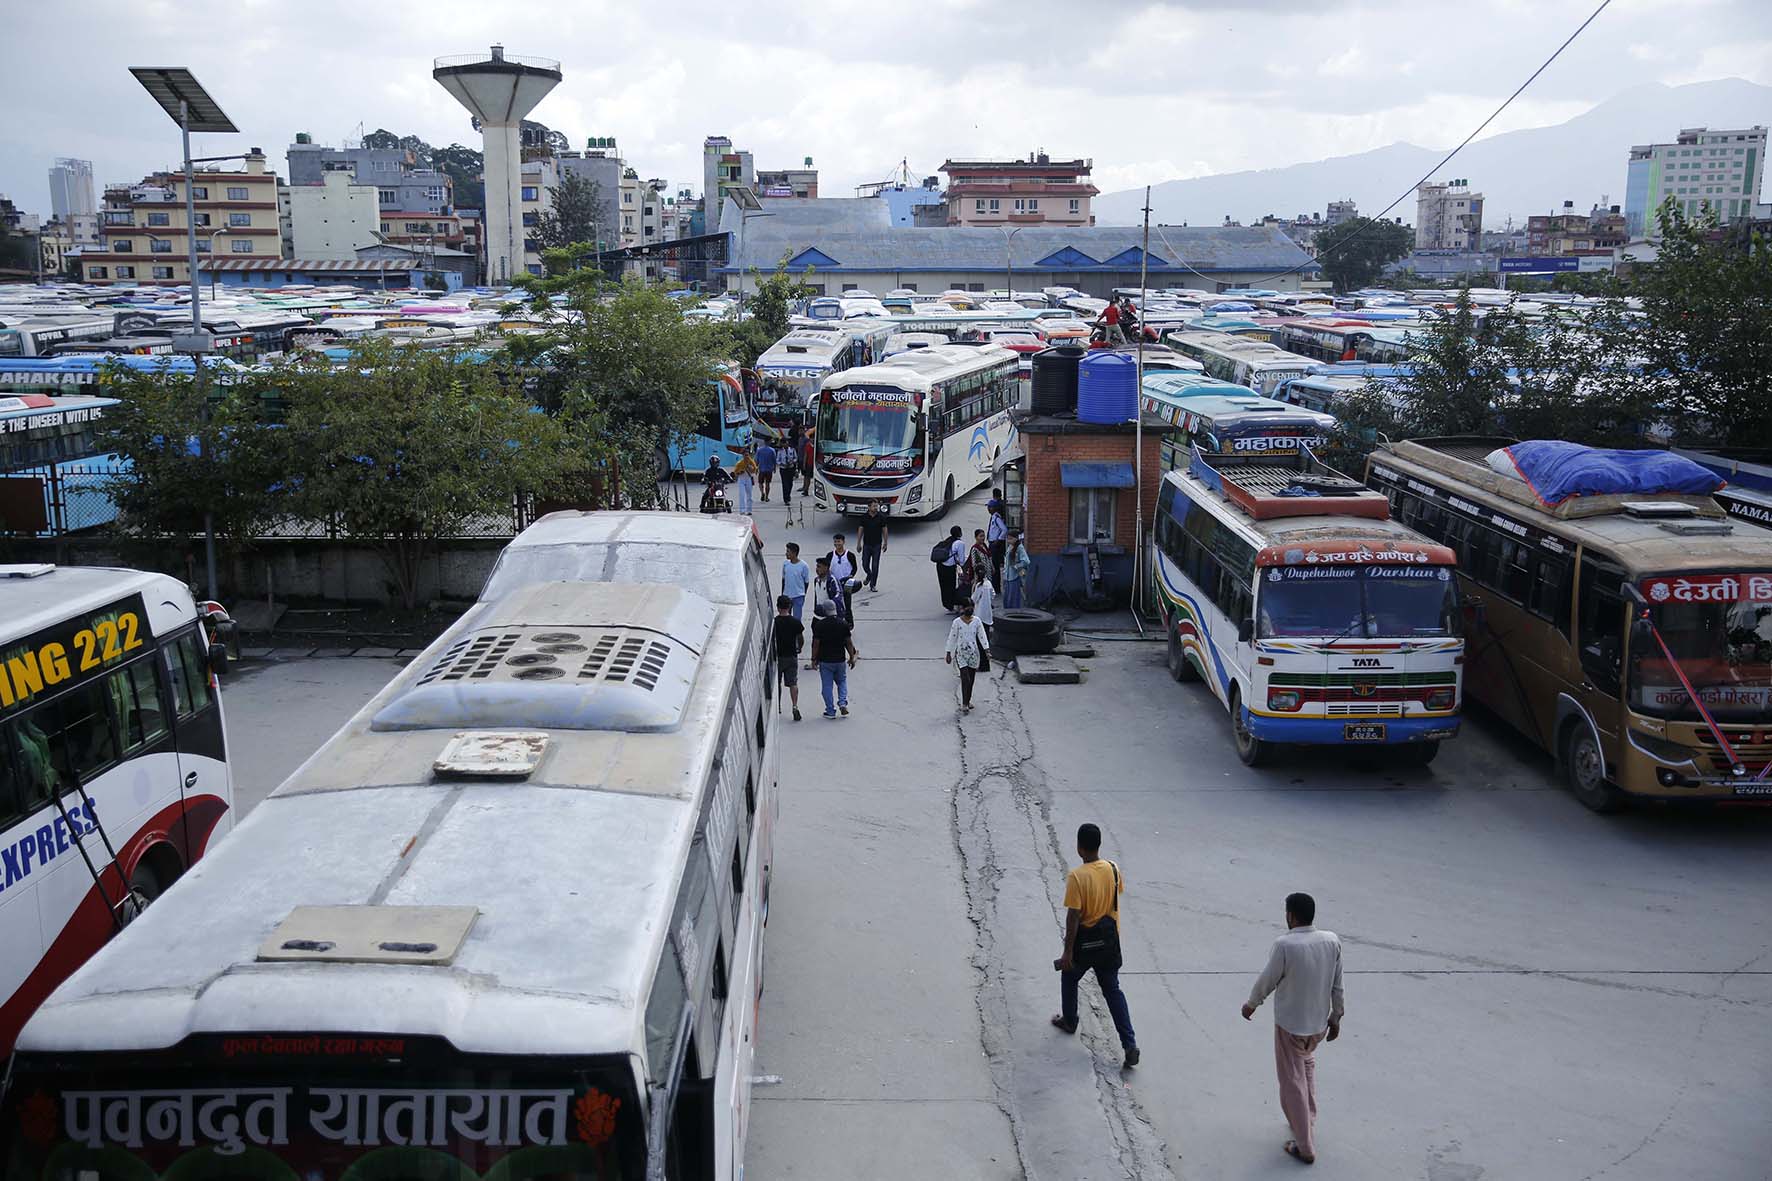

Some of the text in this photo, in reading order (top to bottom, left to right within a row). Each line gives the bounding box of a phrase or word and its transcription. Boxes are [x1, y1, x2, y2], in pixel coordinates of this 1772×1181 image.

[8, 417, 27, 432] THE
[28, 413, 63, 429] UNSEEN
[65, 409, 88, 423] WITH
[1730, 502, 1772, 522] NAMA
[1320, 551, 1346, 563] जय
[1376, 550, 1415, 563] गणेश
[1365, 566, 1434, 578] Darshan
[1673, 577, 1740, 601] देउती
[73, 612, 144, 673] 222
[1352, 658, 1381, 667] TATA
[61, 1087, 575, 1155] पवनदुत यातायात
